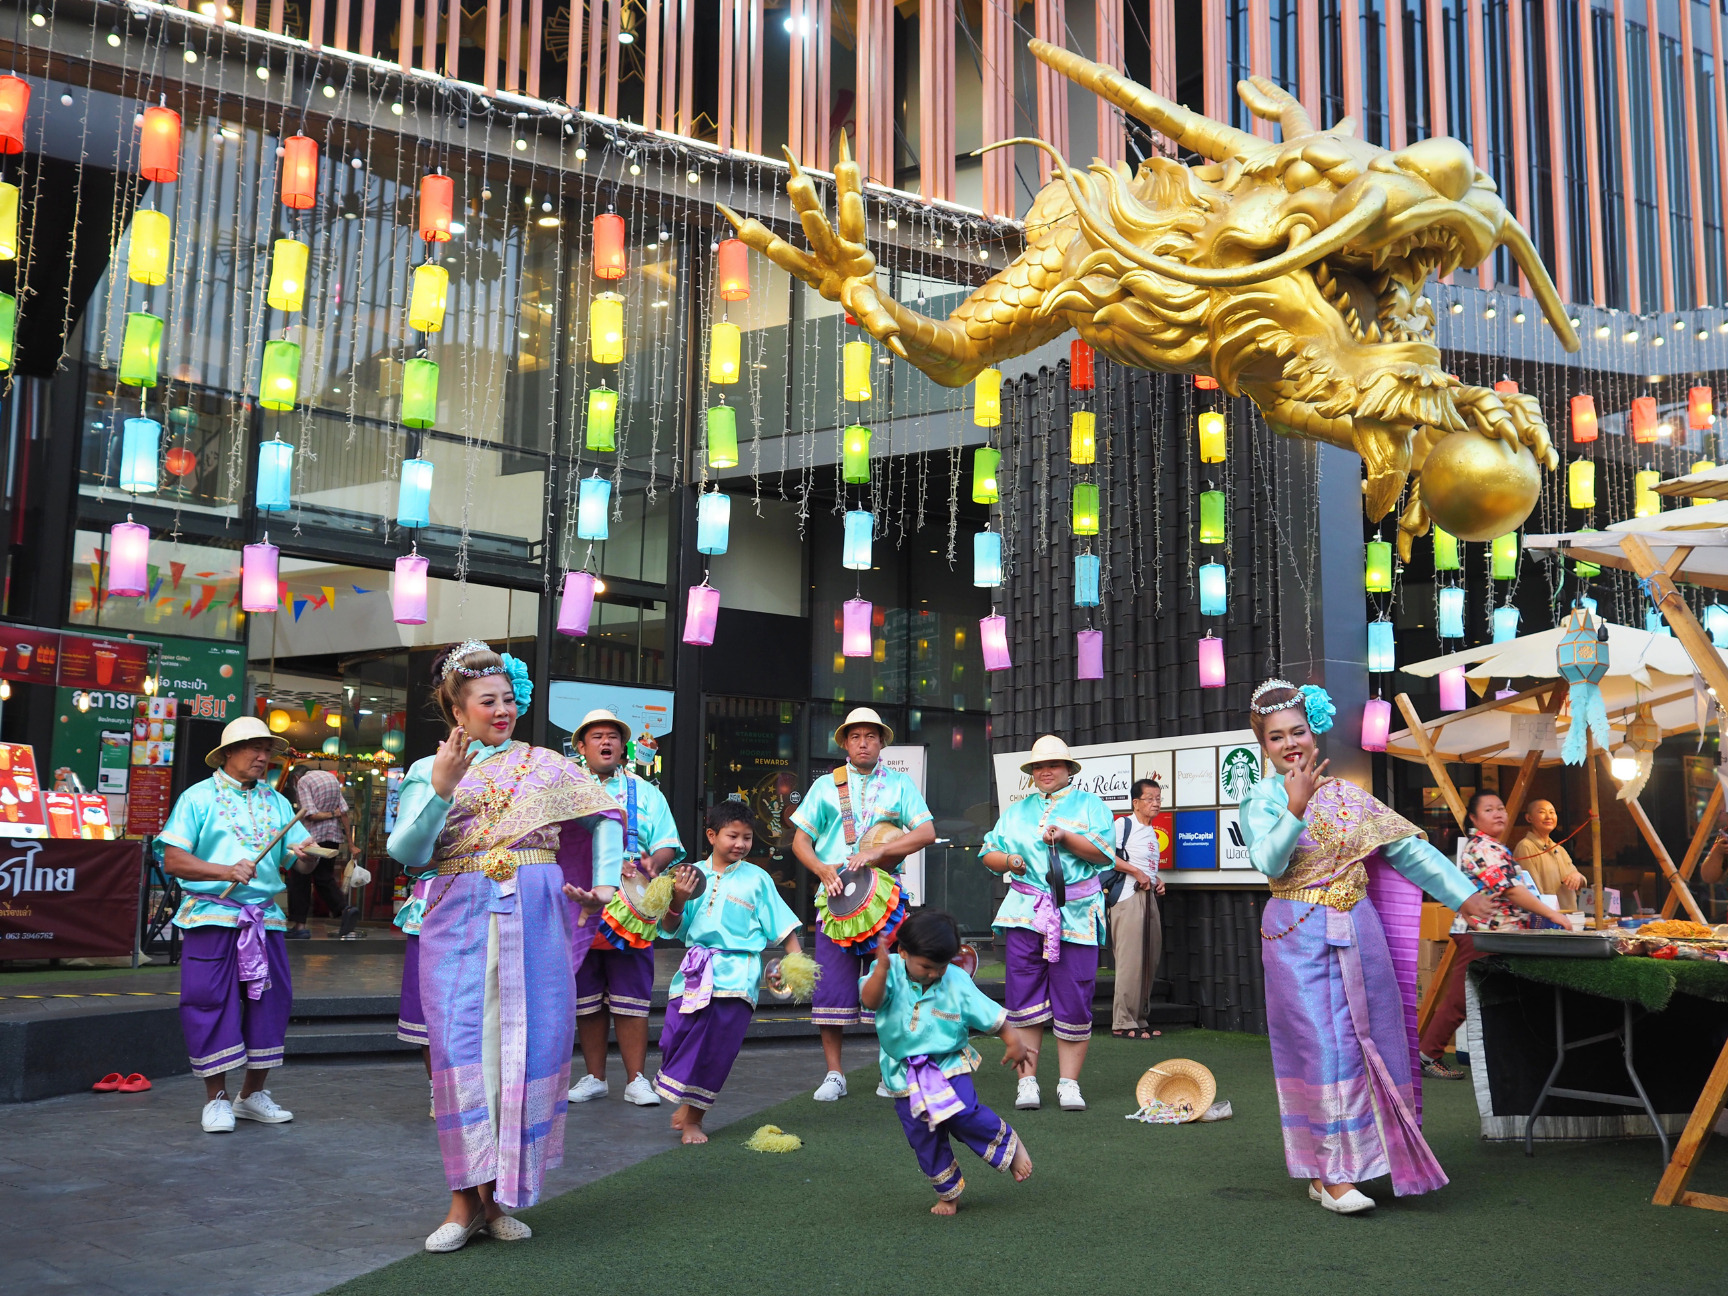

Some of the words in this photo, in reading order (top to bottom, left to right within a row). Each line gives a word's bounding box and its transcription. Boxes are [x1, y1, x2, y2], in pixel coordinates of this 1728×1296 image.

[1517, 722, 1555, 741] FREE
[754, 758, 789, 766] REWARDS
[1092, 773, 1129, 795] Relax
[1178, 832, 1214, 842] PhillipCapital
[5, 932, 20, 940] 063
